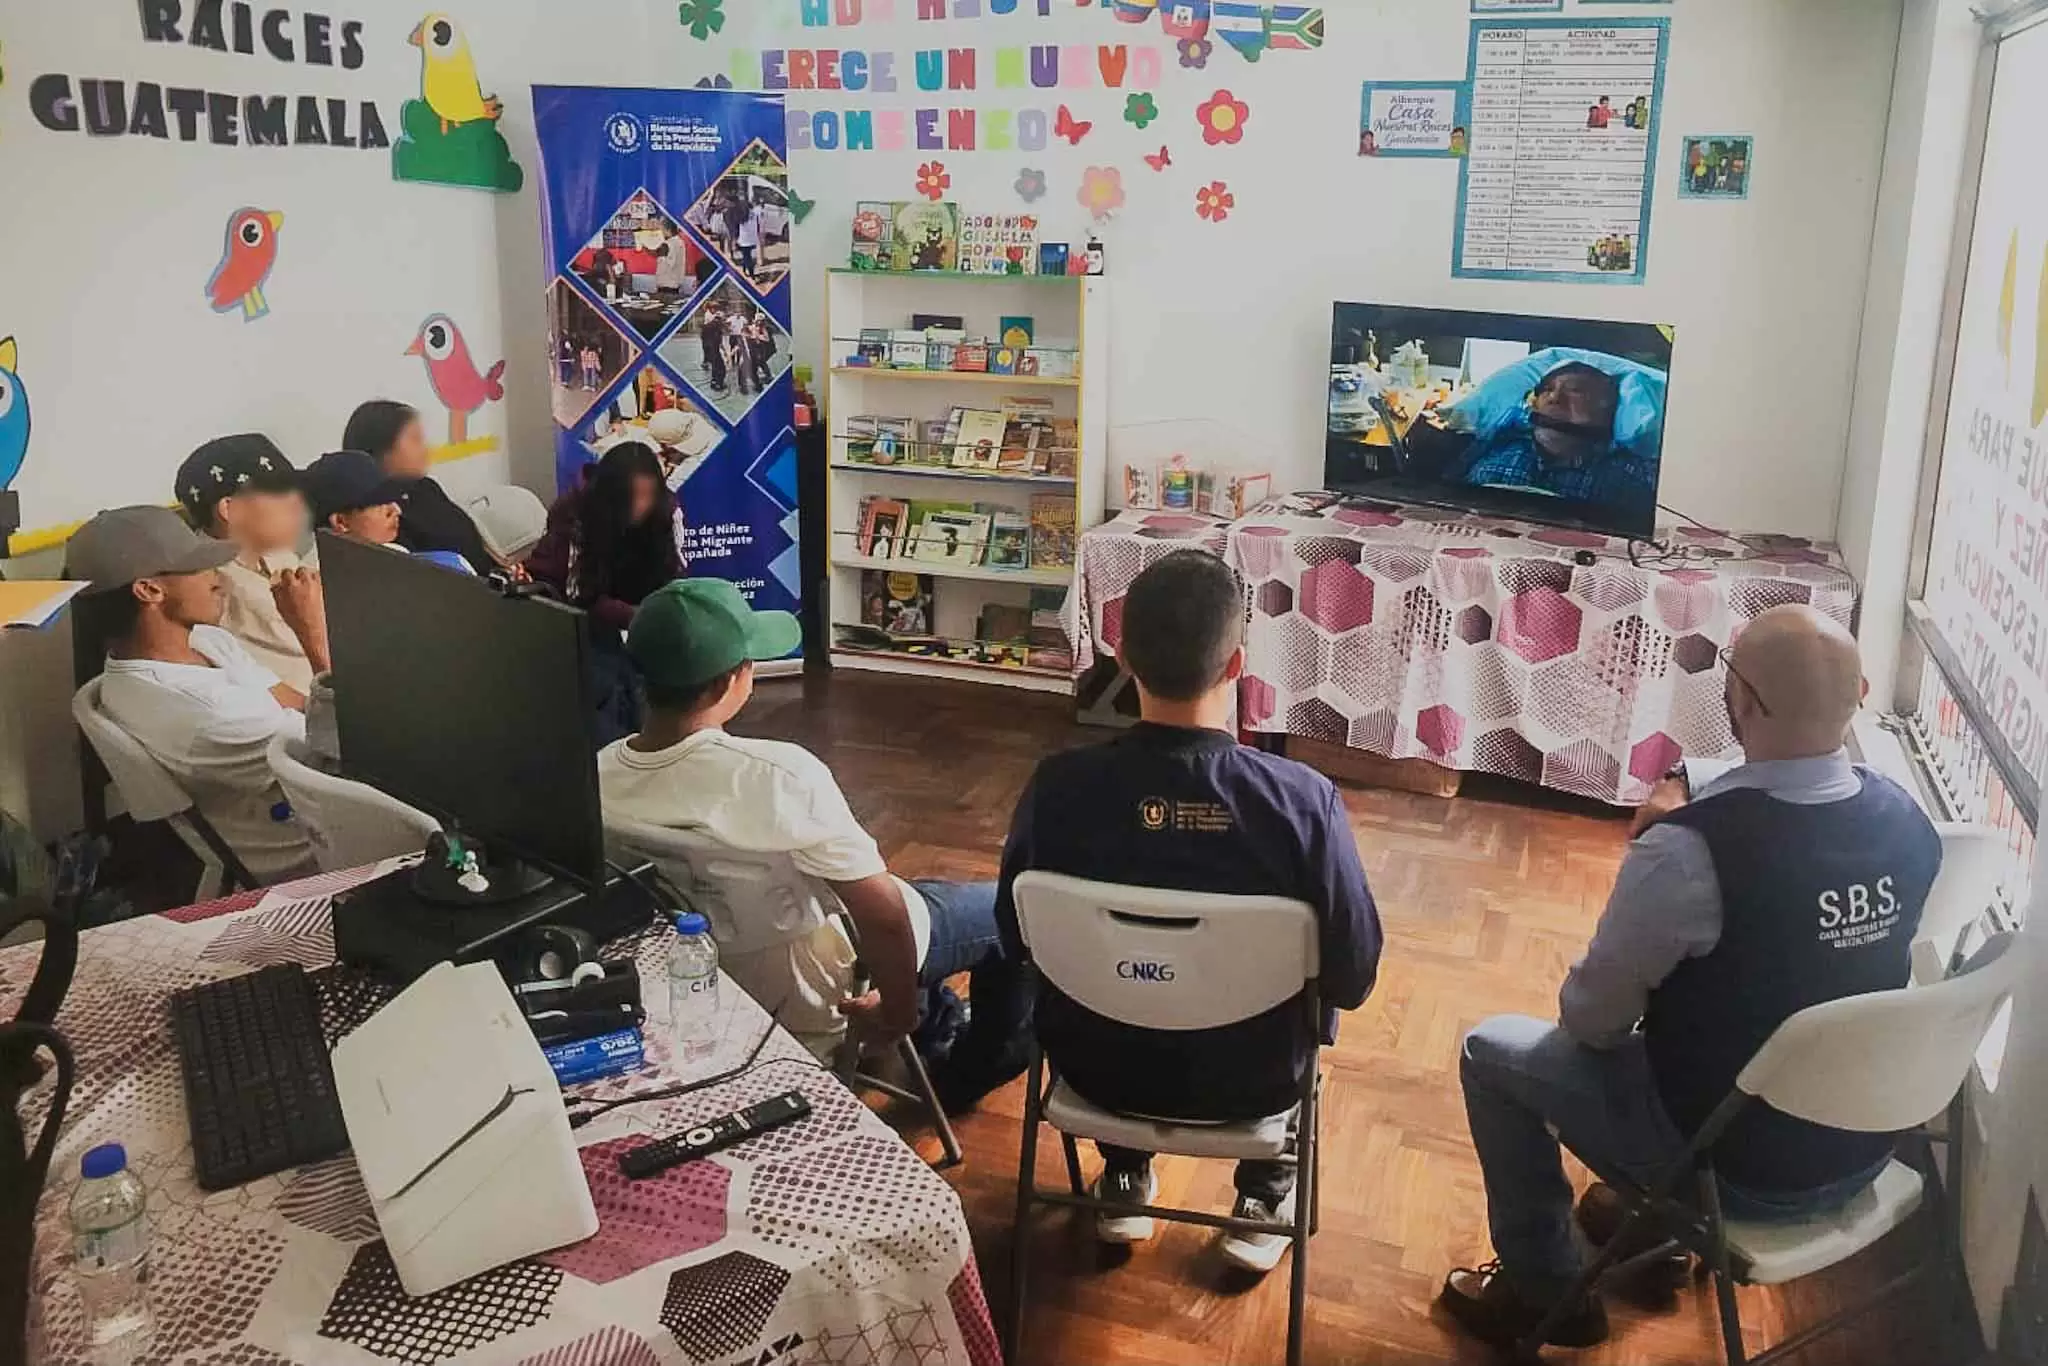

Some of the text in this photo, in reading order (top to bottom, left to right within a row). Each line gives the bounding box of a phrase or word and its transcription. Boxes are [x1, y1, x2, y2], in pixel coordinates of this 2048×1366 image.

[1567, 30, 1616, 38] ACTIVIDAD
[728, 45, 1163, 92] ERECE UN UEVO
[29, 73, 390, 149] GUATEMALA
[1388, 104, 1435, 121] Casa
[786, 108, 1048, 151] COMENZO
[699, 525, 714, 536] de
[716, 523, 750, 534] Niñez
[701, 536, 753, 548] Migrante
[730, 577, 765, 589] cción
[1818, 876, 1901, 928] S.B.S.
[1116, 960, 1175, 981] CNRG
